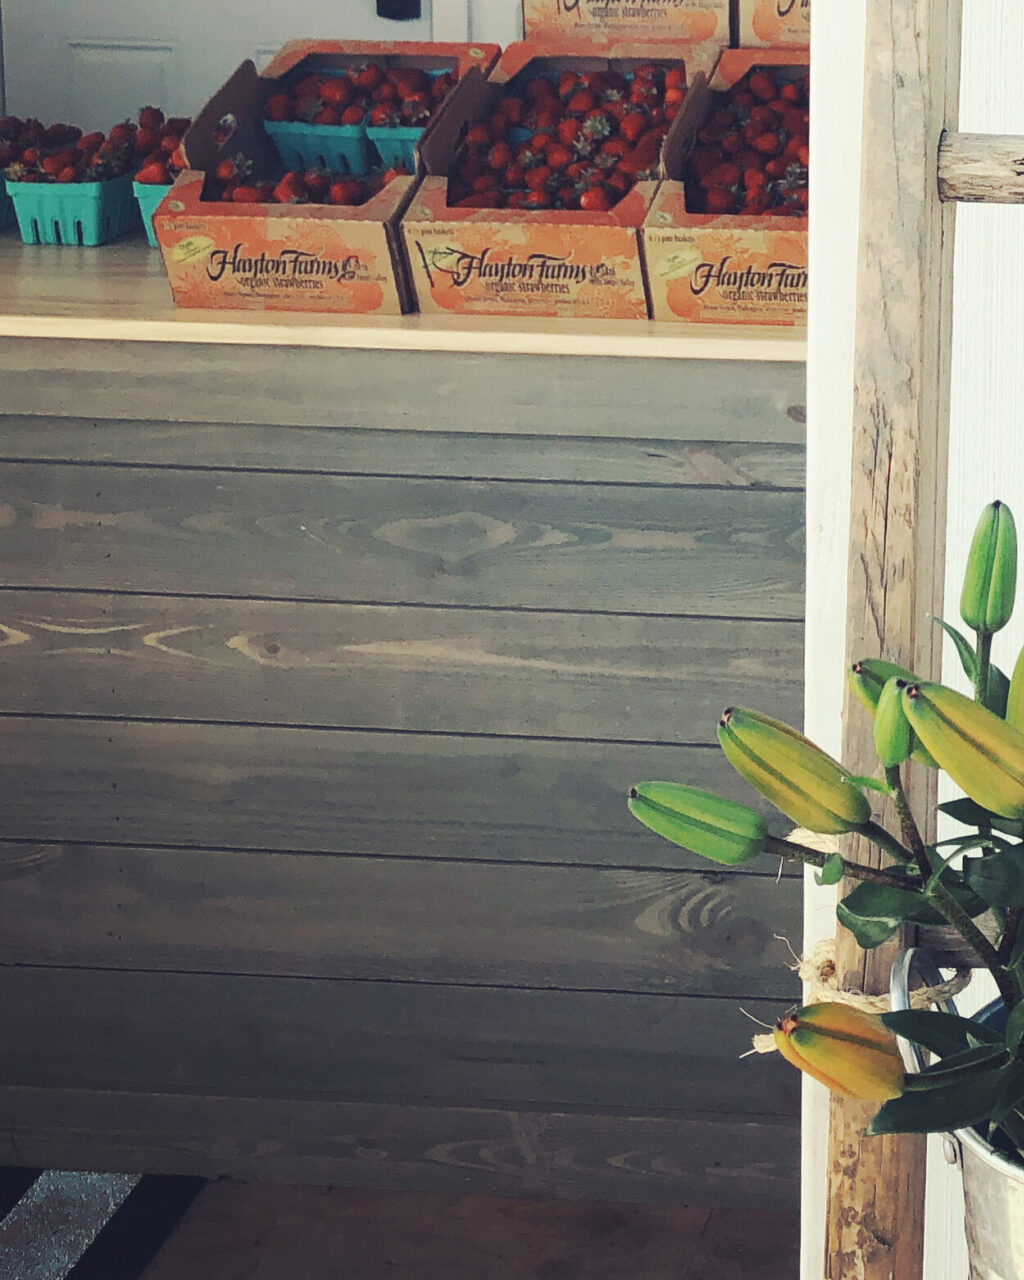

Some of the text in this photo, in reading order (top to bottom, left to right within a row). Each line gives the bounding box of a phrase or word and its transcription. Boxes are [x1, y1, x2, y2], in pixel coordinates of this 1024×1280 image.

[206, 243, 286, 281] Hayton
[281, 249, 343, 280] Farms
[453, 247, 534, 287] Hayton
[528, 252, 587, 284] Farms
[690, 256, 772, 295] Hayton
